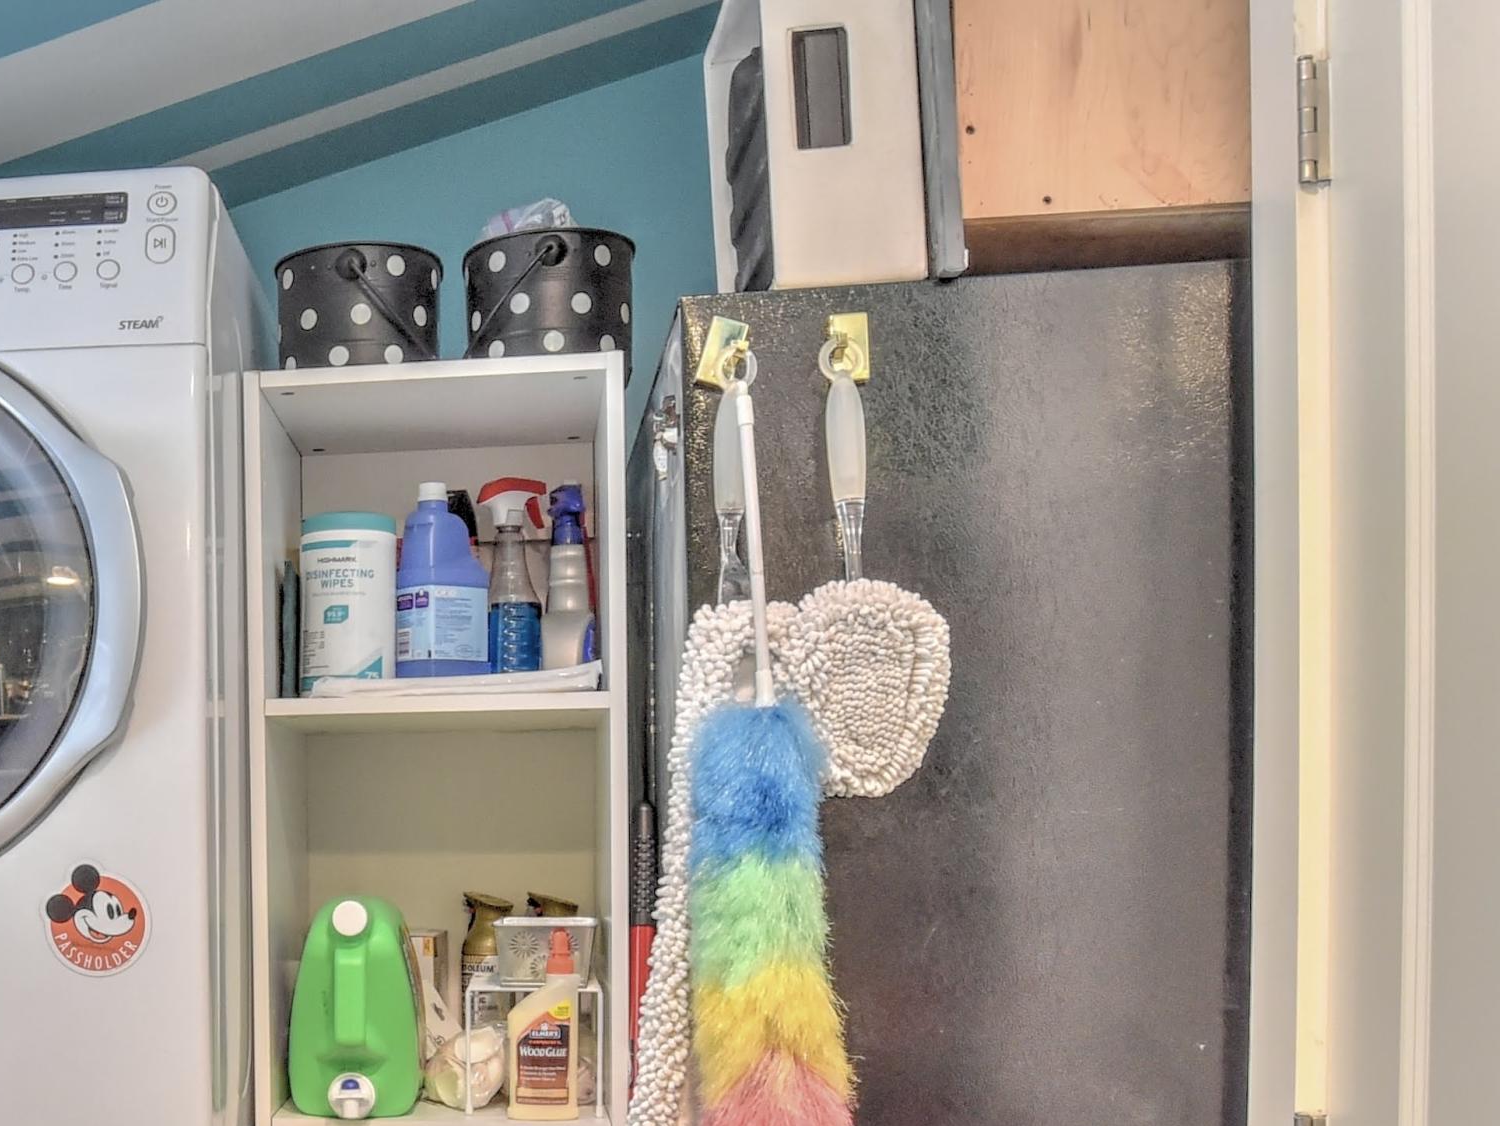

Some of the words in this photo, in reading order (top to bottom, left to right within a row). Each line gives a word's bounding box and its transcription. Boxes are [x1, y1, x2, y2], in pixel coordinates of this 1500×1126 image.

[118, 318, 161, 331] STEAM
[306, 568, 376, 581] DISINFECTING
[320, 578, 355, 589] WIPES
[54, 932, 139, 970] PASSHOLDER
